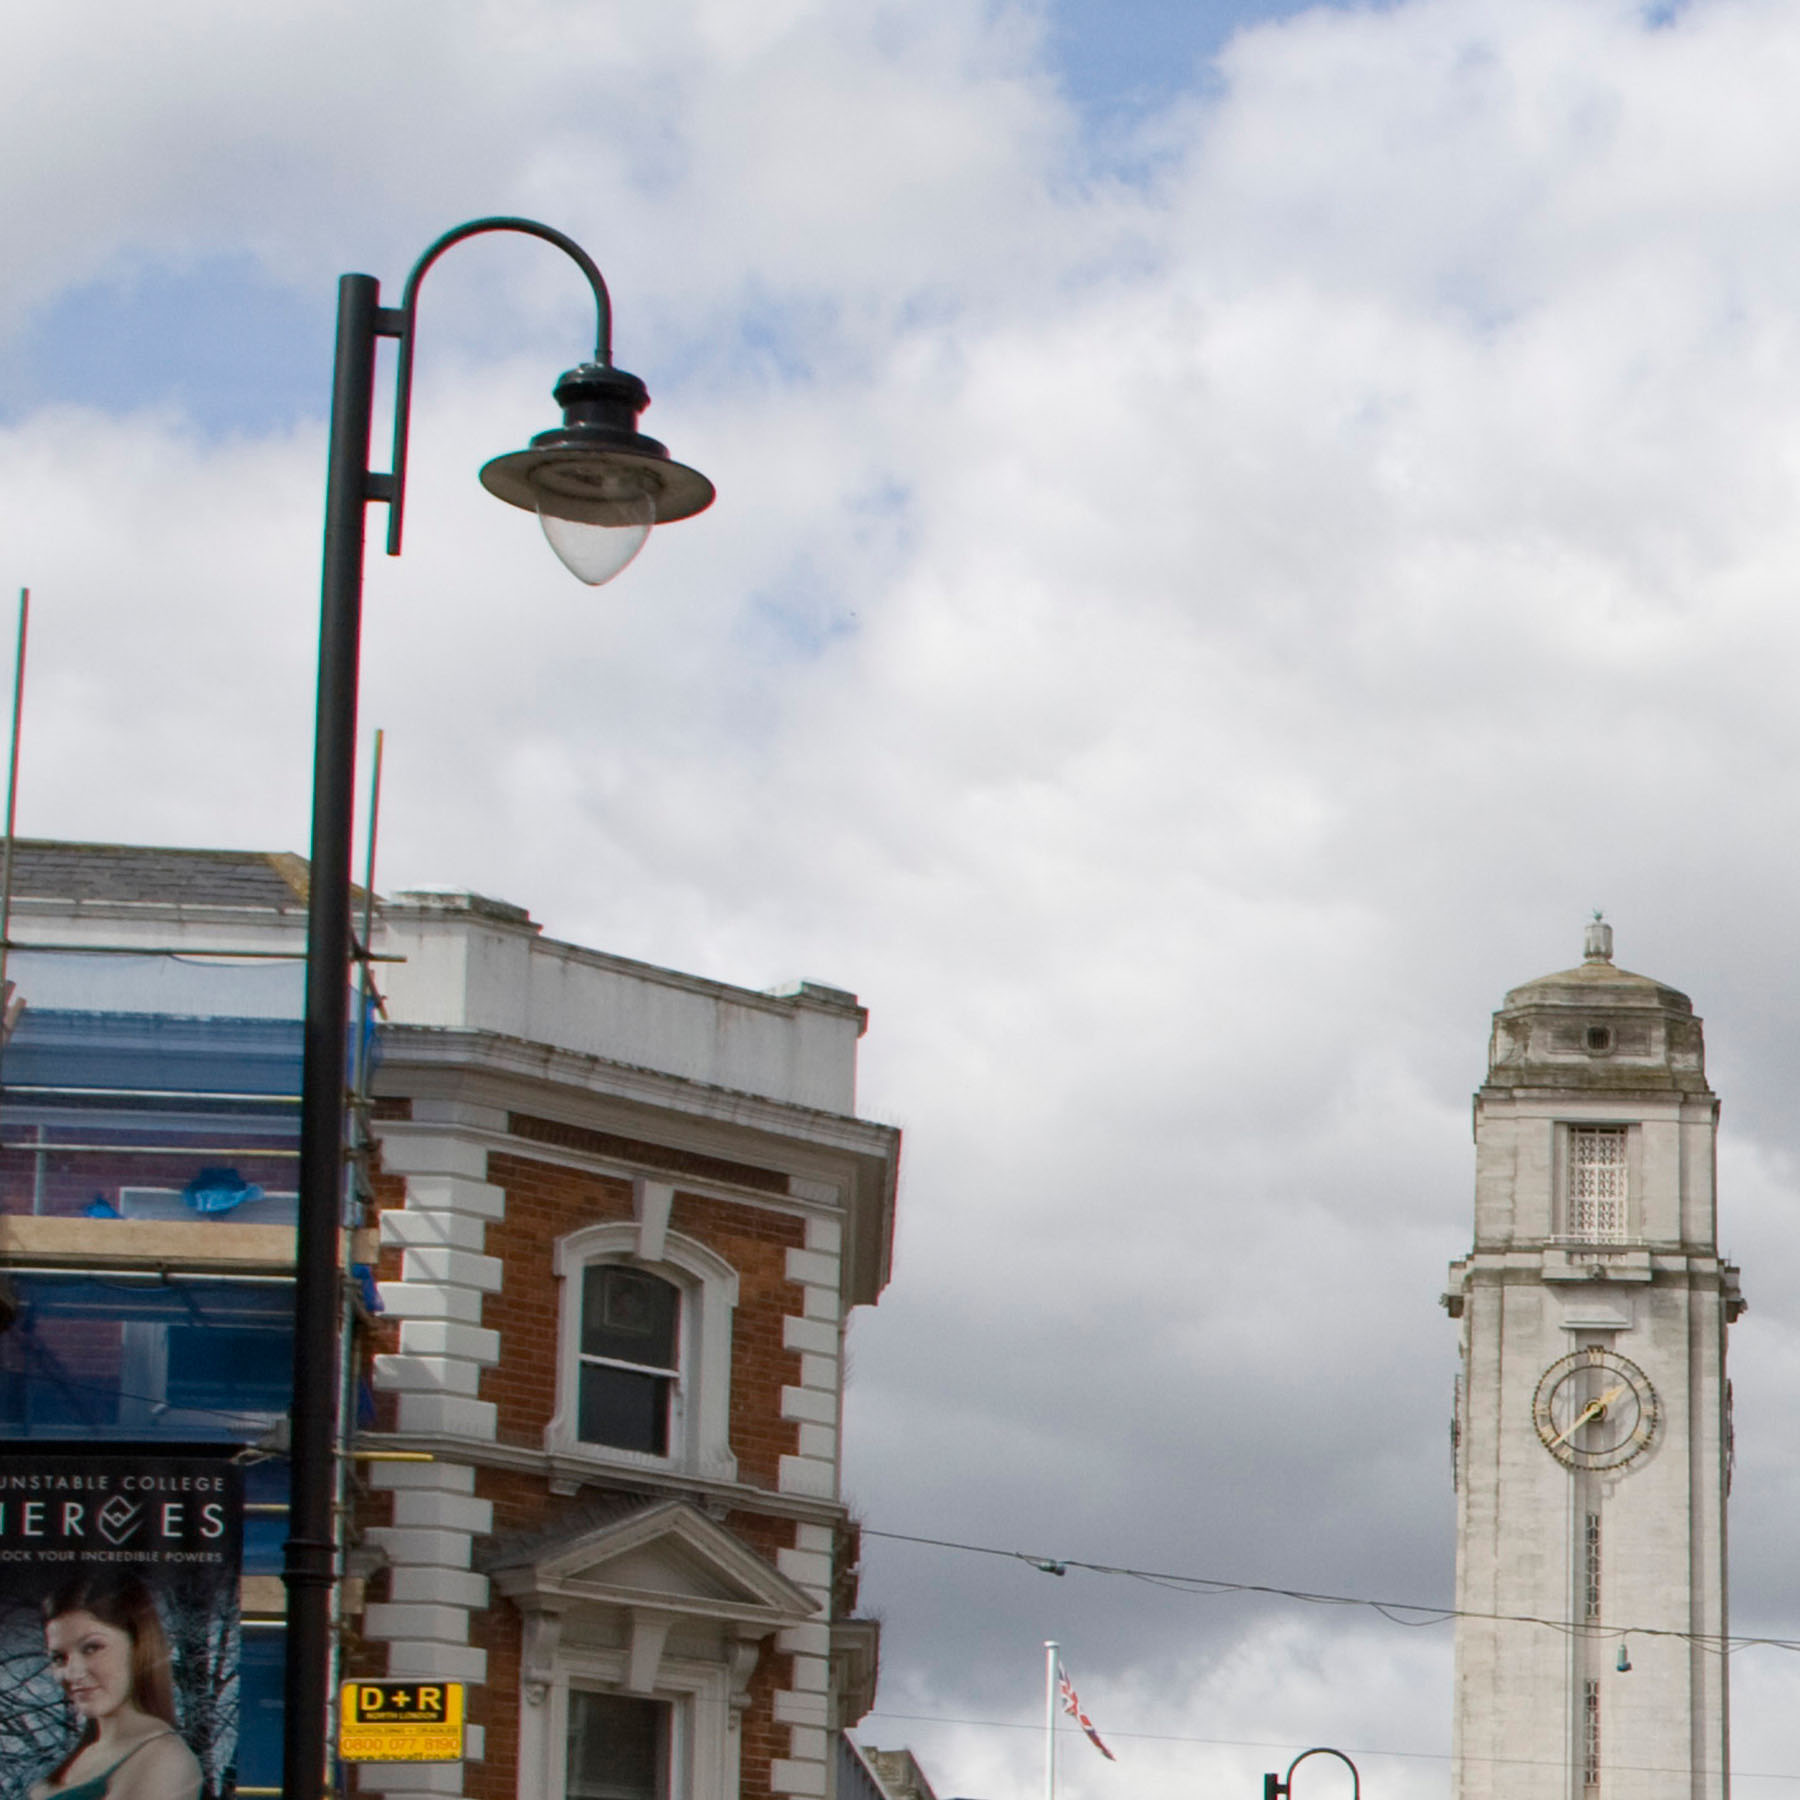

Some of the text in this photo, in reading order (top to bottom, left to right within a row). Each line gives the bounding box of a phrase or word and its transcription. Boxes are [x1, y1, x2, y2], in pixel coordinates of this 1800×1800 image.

[123, 1477, 224, 1491] COLLEGE
[38, 1552, 75, 1562] YOUR
[81, 1552, 159, 1562] INCREDIBLE
[165, 1552, 223, 1563] POWERS
